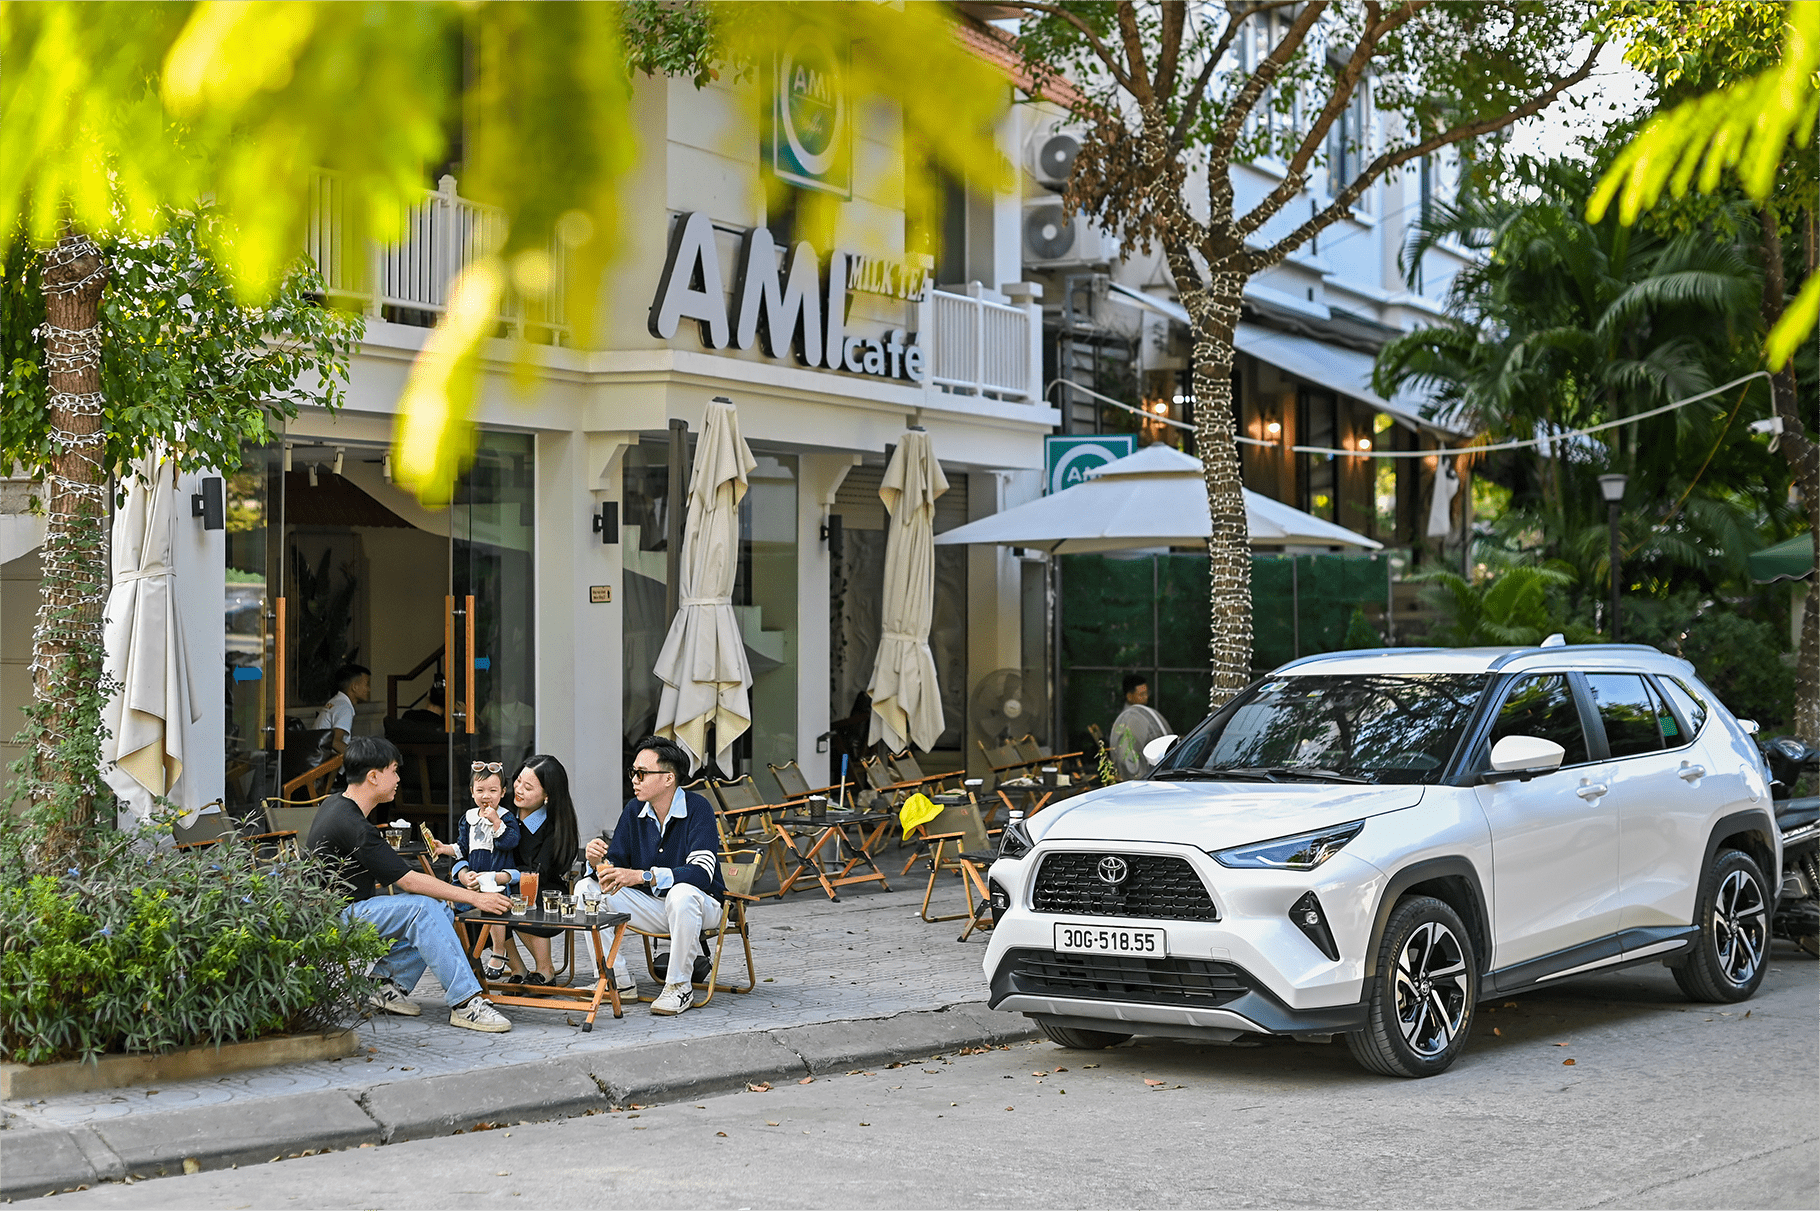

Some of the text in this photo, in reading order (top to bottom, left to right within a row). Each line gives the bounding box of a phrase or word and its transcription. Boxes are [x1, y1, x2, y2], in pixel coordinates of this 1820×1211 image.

[794, 65, 831, 104] AMI
[651, 211, 847, 370] AMI
[848, 254, 894, 296] MILK
[1064, 929, 1155, 952] 30G-518.55
